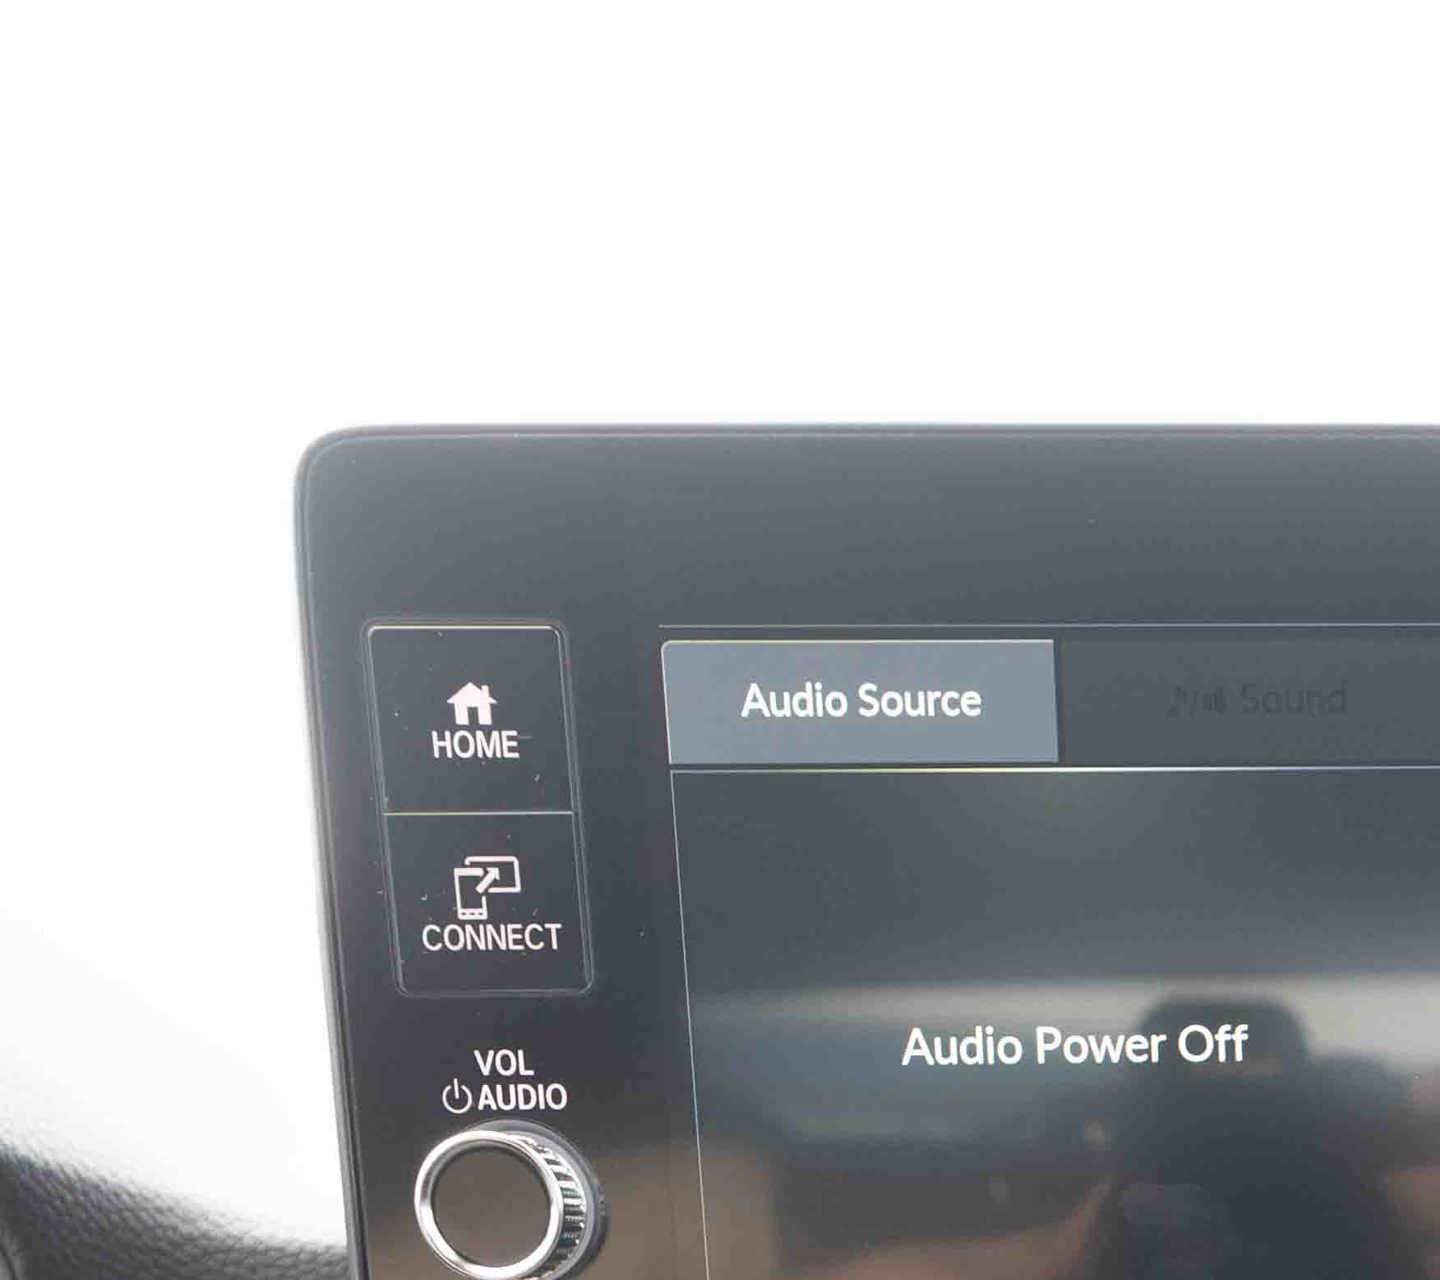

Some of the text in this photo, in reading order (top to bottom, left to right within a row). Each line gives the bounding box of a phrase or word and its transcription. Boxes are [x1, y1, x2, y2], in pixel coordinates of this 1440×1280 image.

[740, 681, 982, 719] Audio Source
[431, 730, 520, 760] HOME
[421, 923, 562, 953] CONNECT
[901, 1022, 1250, 1067] Audio Power Off
[473, 1048, 535, 1078] VOL
[477, 1082, 569, 1112] AUDIO
